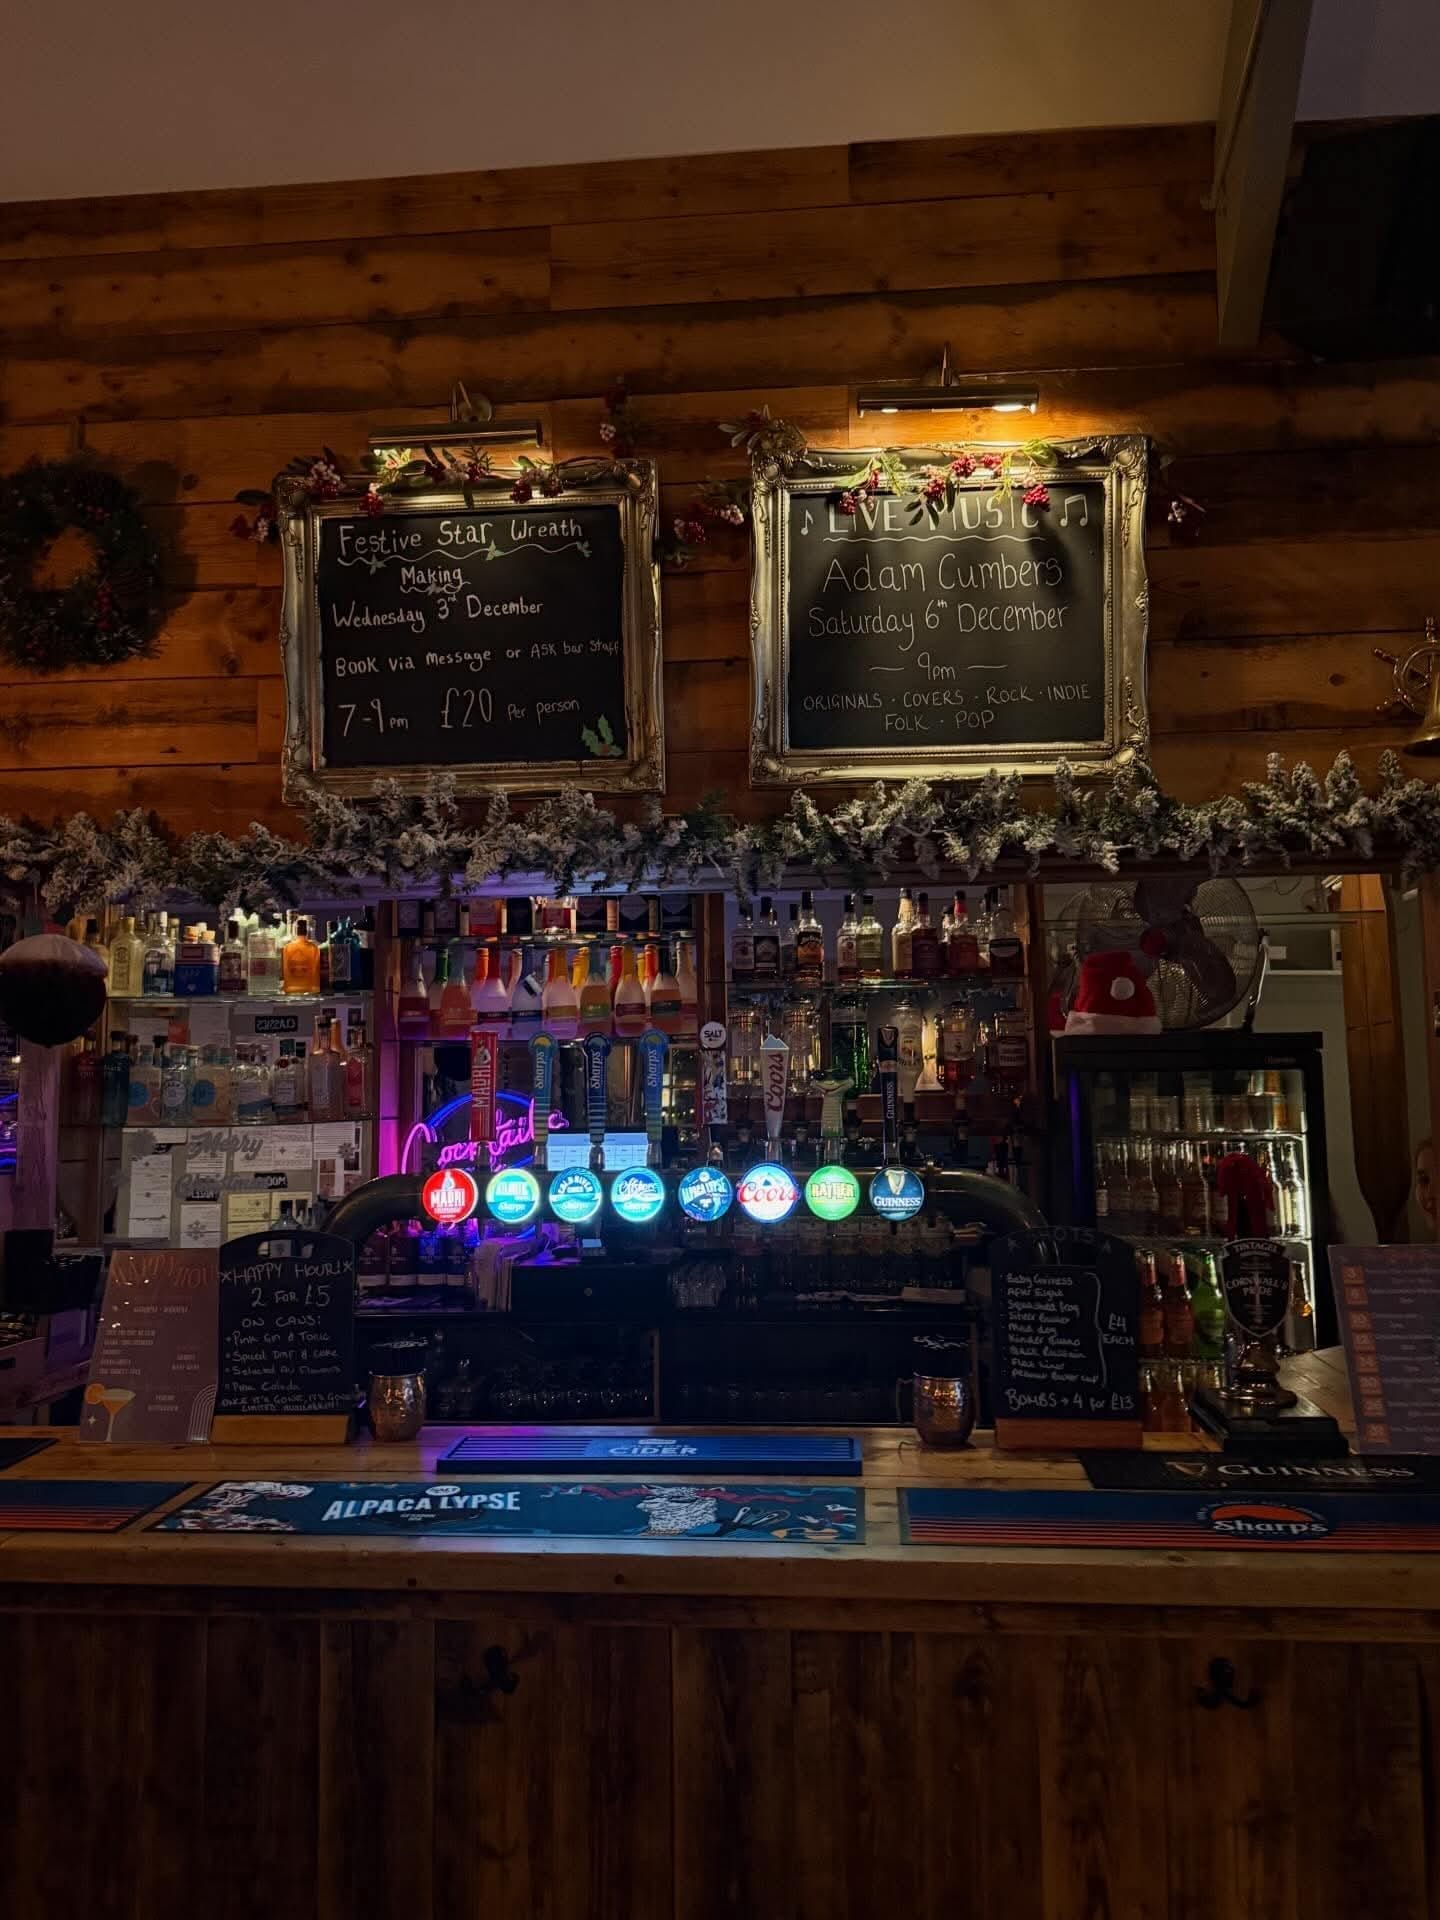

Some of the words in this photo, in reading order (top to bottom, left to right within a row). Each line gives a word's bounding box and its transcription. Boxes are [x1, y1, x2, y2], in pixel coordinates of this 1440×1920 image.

[828, 500, 903, 533] LIVE
[929, 496, 1038, 532] MUSIC
[338, 523, 422, 556] Festive
[437, 520, 492, 545] Star
[510, 518, 583, 540] Wreath
[401, 566, 463, 591] Making
[823, 554, 926, 593] Adam
[938, 553, 1063, 590] Cumbers
[332, 601, 425, 633] Wednesday
[437, 595, 457, 620] 3rd
[466, 594, 544, 618] December
[808, 605, 915, 651] Saturday
[925, 599, 948, 629] 6th
[958, 601, 1068, 632] December
[506, 647, 521, 659] or
[563, 641, 584, 653] bar
[917, 652, 956, 682] 9pm
[440, 688, 493, 729] £20
[536, 698, 581, 725] person
[803, 693, 883, 711] ORIGINALS
[903, 689, 965, 707] COVERS
[986, 685, 1034, 704] ROCK
[1047, 684, 1091, 701] INDIE
[885, 714, 929, 731] FOLK
[955, 710, 995, 729] POP
[704, 1030, 723, 1039] SALT
[766, 1053, 784, 1113] Coors
[738, 1182, 798, 1205] Coors
[873, 1195, 920, 1207] GUINNESS
[234, 1262, 282, 1286] HAPPY
[251, 1287, 266, 1307] 2
[305, 1284, 330, 1307] £5
[1107, 1312, 1127, 1333] £4
[1111, 1392, 1135, 1411] £13
[608, 1447, 698, 1455] CIDER
[1218, 1463, 1416, 1480] GUINNESS
